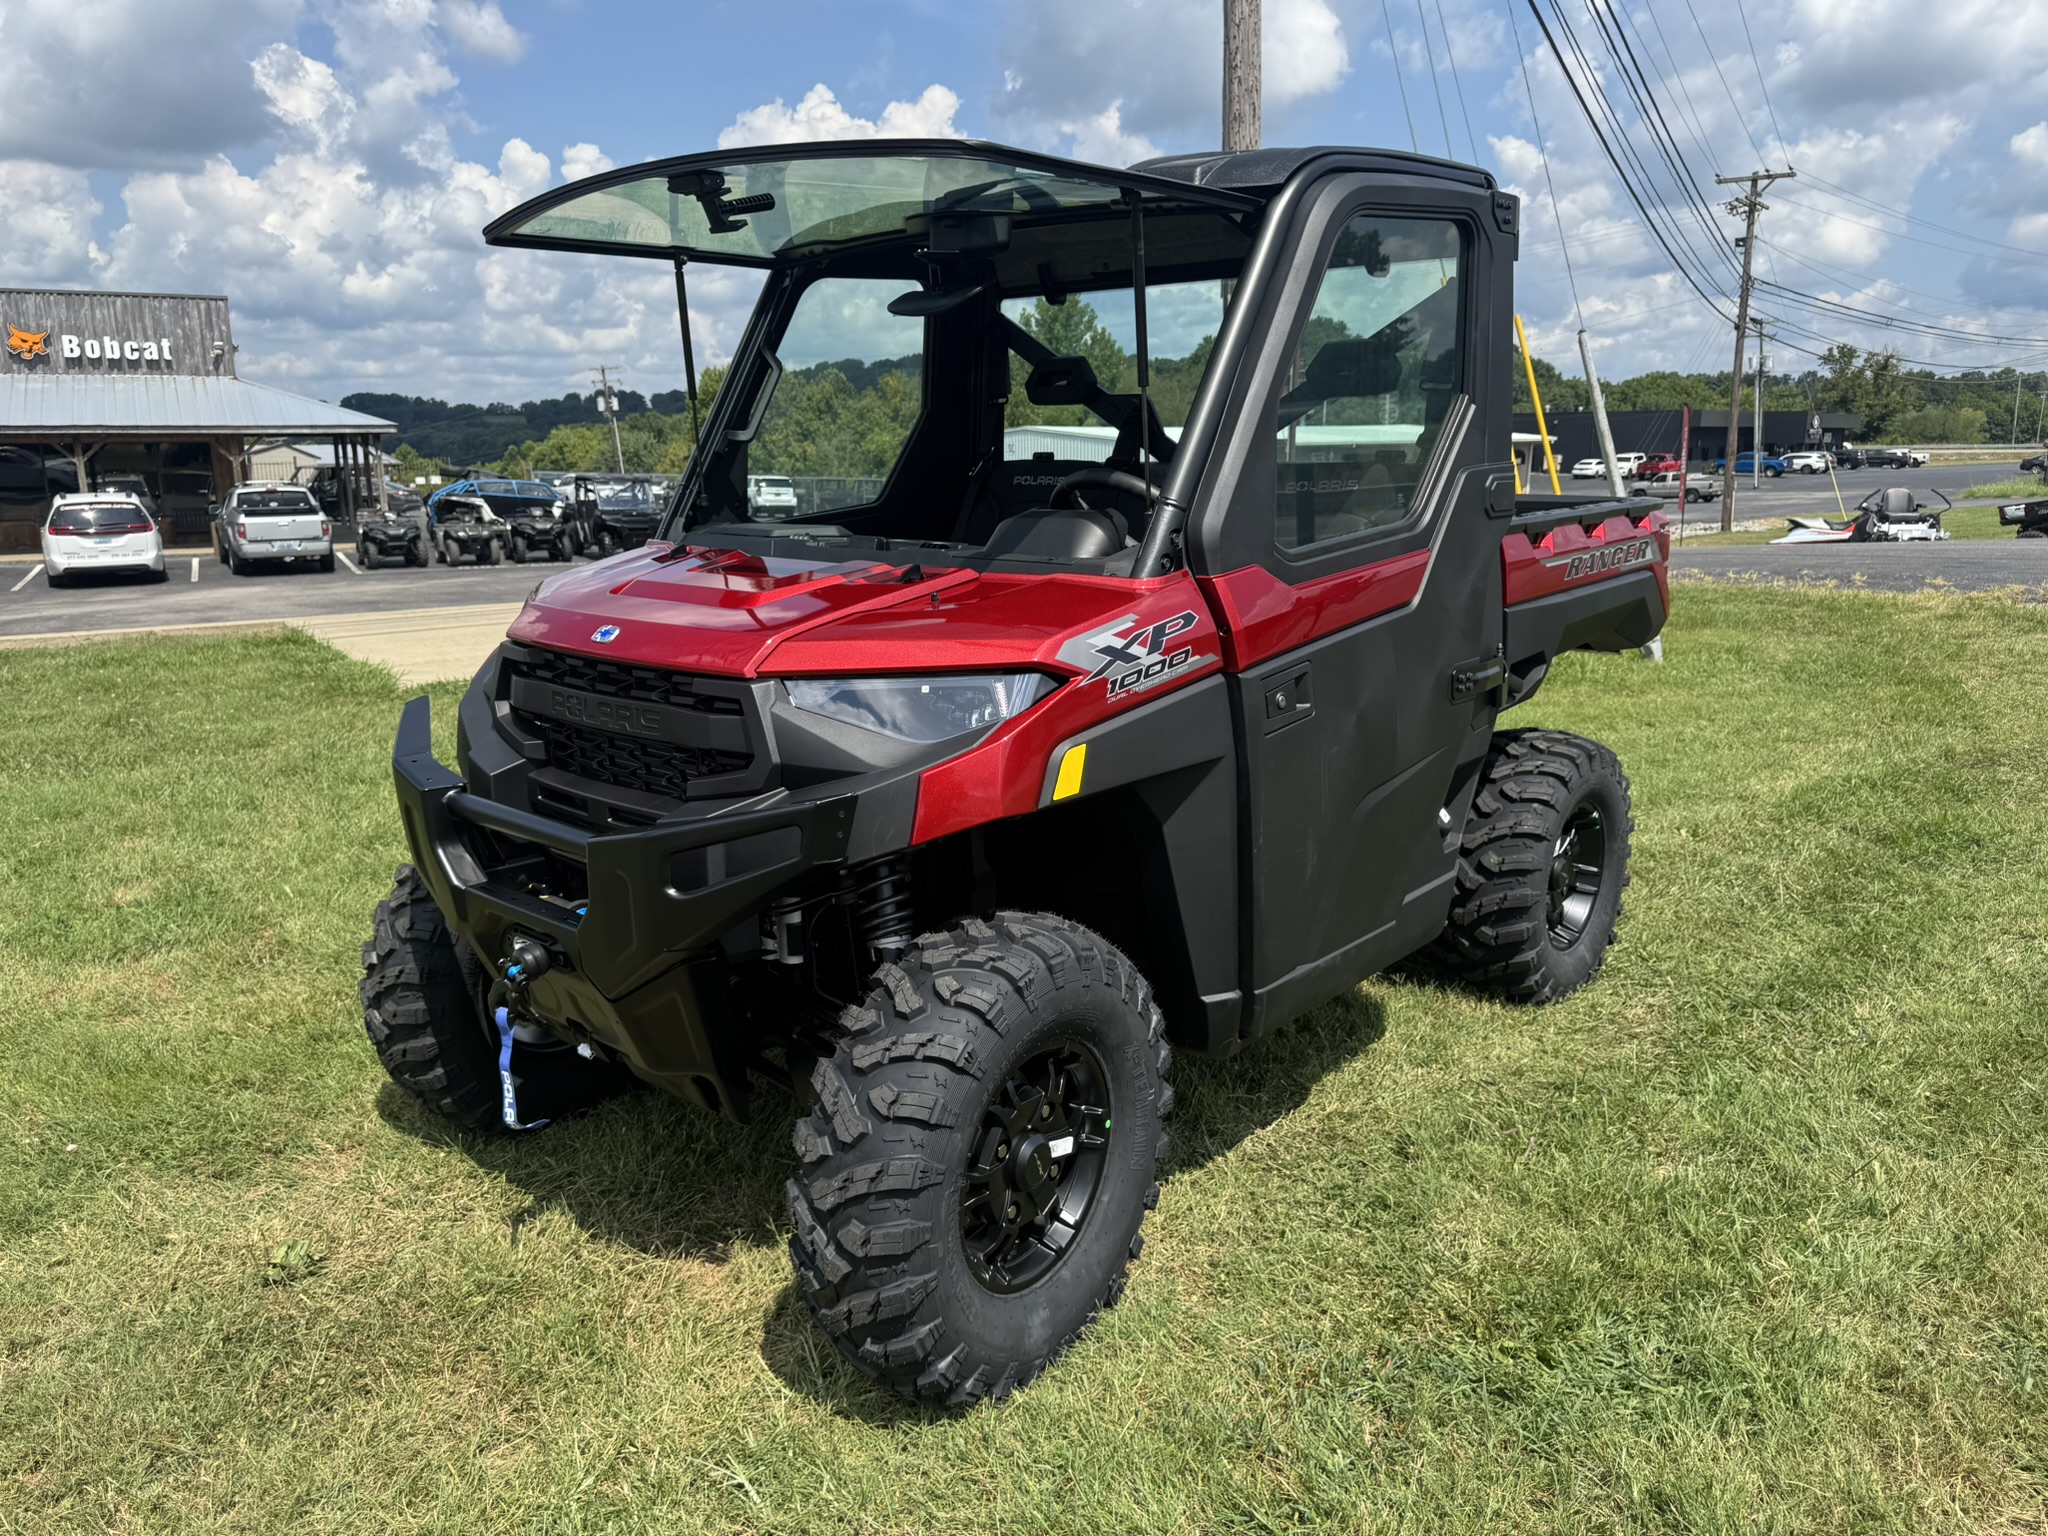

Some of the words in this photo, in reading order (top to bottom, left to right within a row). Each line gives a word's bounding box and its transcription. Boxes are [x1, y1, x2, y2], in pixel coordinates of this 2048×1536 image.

[61, 335, 172, 360] Bobcat
[1013, 476, 1066, 486] POLARIS
[1285, 480, 1359, 492] POLARIS
[1564, 539, 1650, 580] RANGER
[1077, 610, 1199, 688] XP
[1107, 646, 1192, 697] 1000
[1107, 692, 1128, 704] DUAL
[1130, 673, 1171, 694] OVERHEAD
[1171, 665, 1189, 678] CAM
[552, 690, 660, 736] POLARIS
